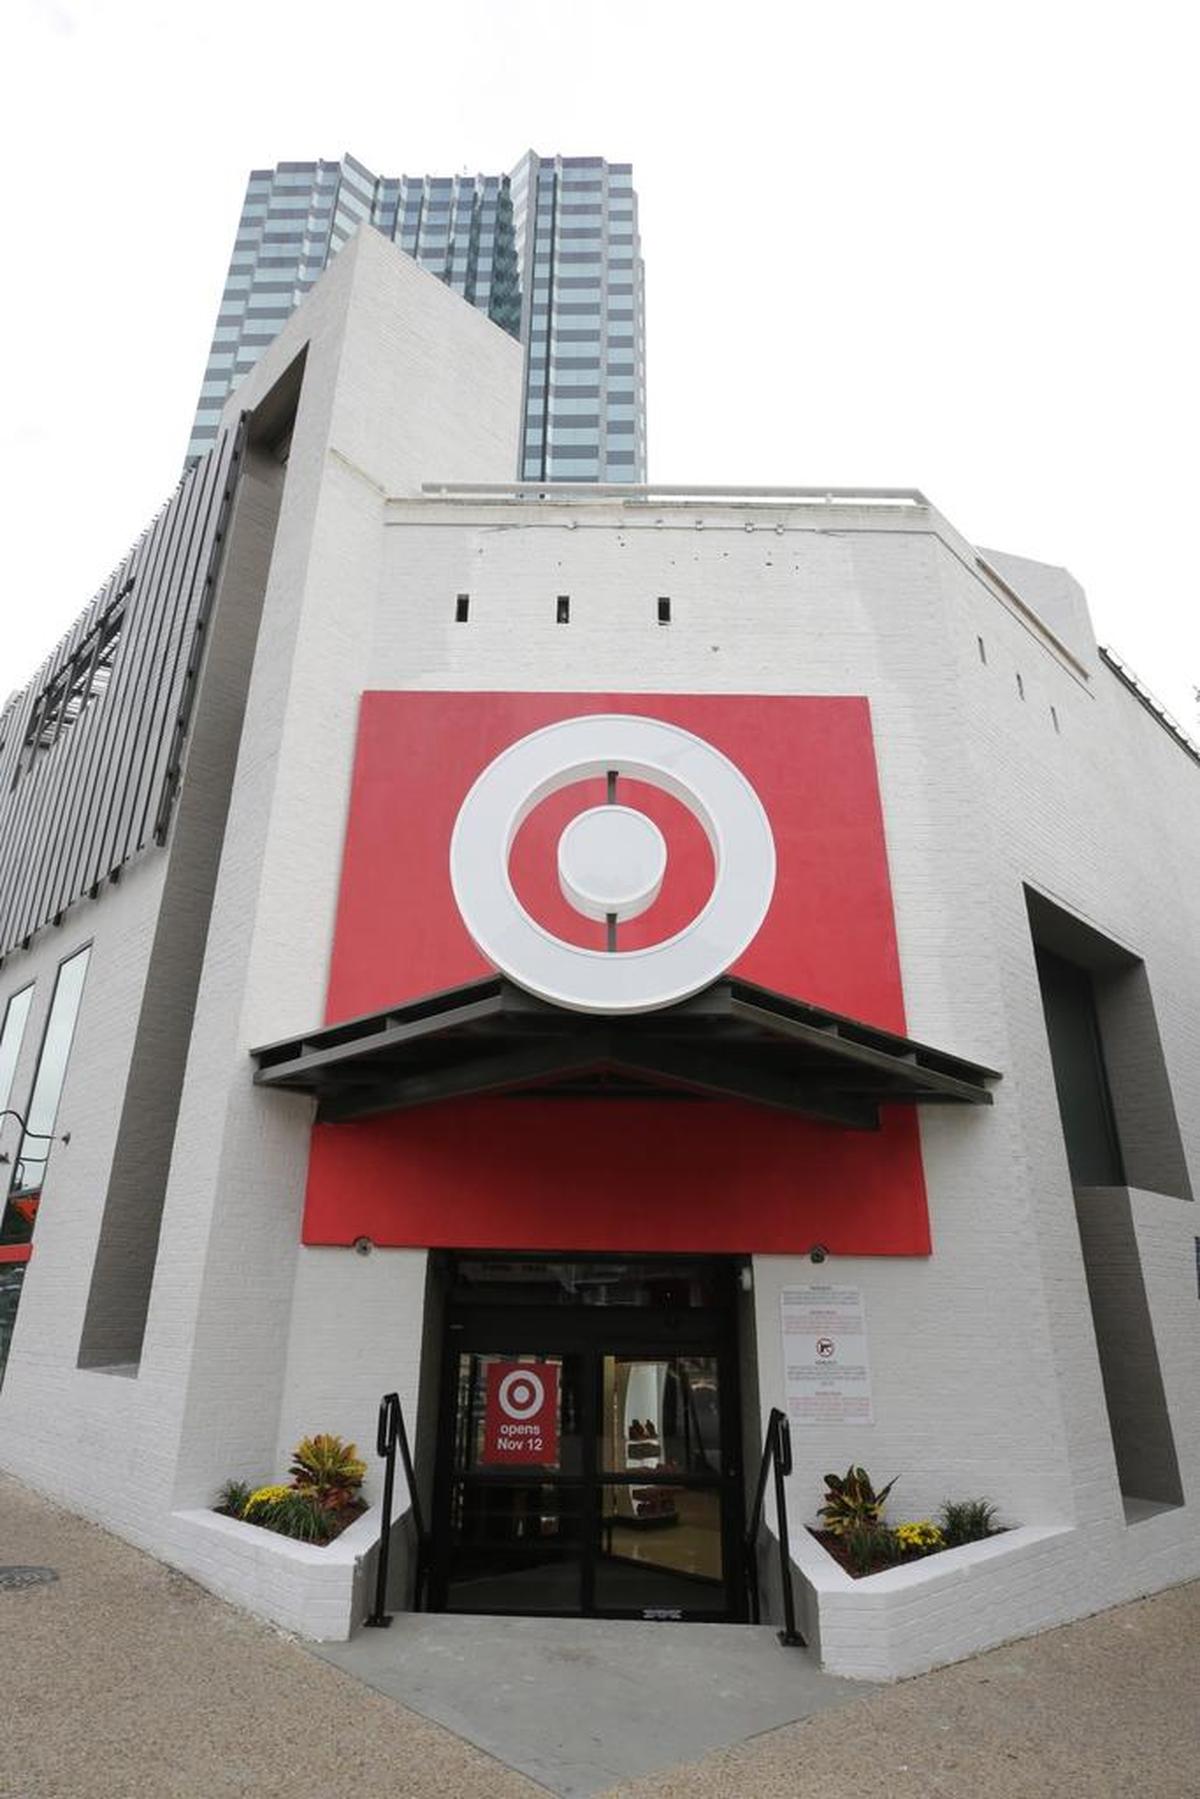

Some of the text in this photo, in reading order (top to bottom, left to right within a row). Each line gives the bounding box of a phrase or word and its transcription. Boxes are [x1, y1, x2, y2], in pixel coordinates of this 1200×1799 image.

[500, 1424, 541, 1437] opens
[497, 1437, 544, 1451] Nov 12
